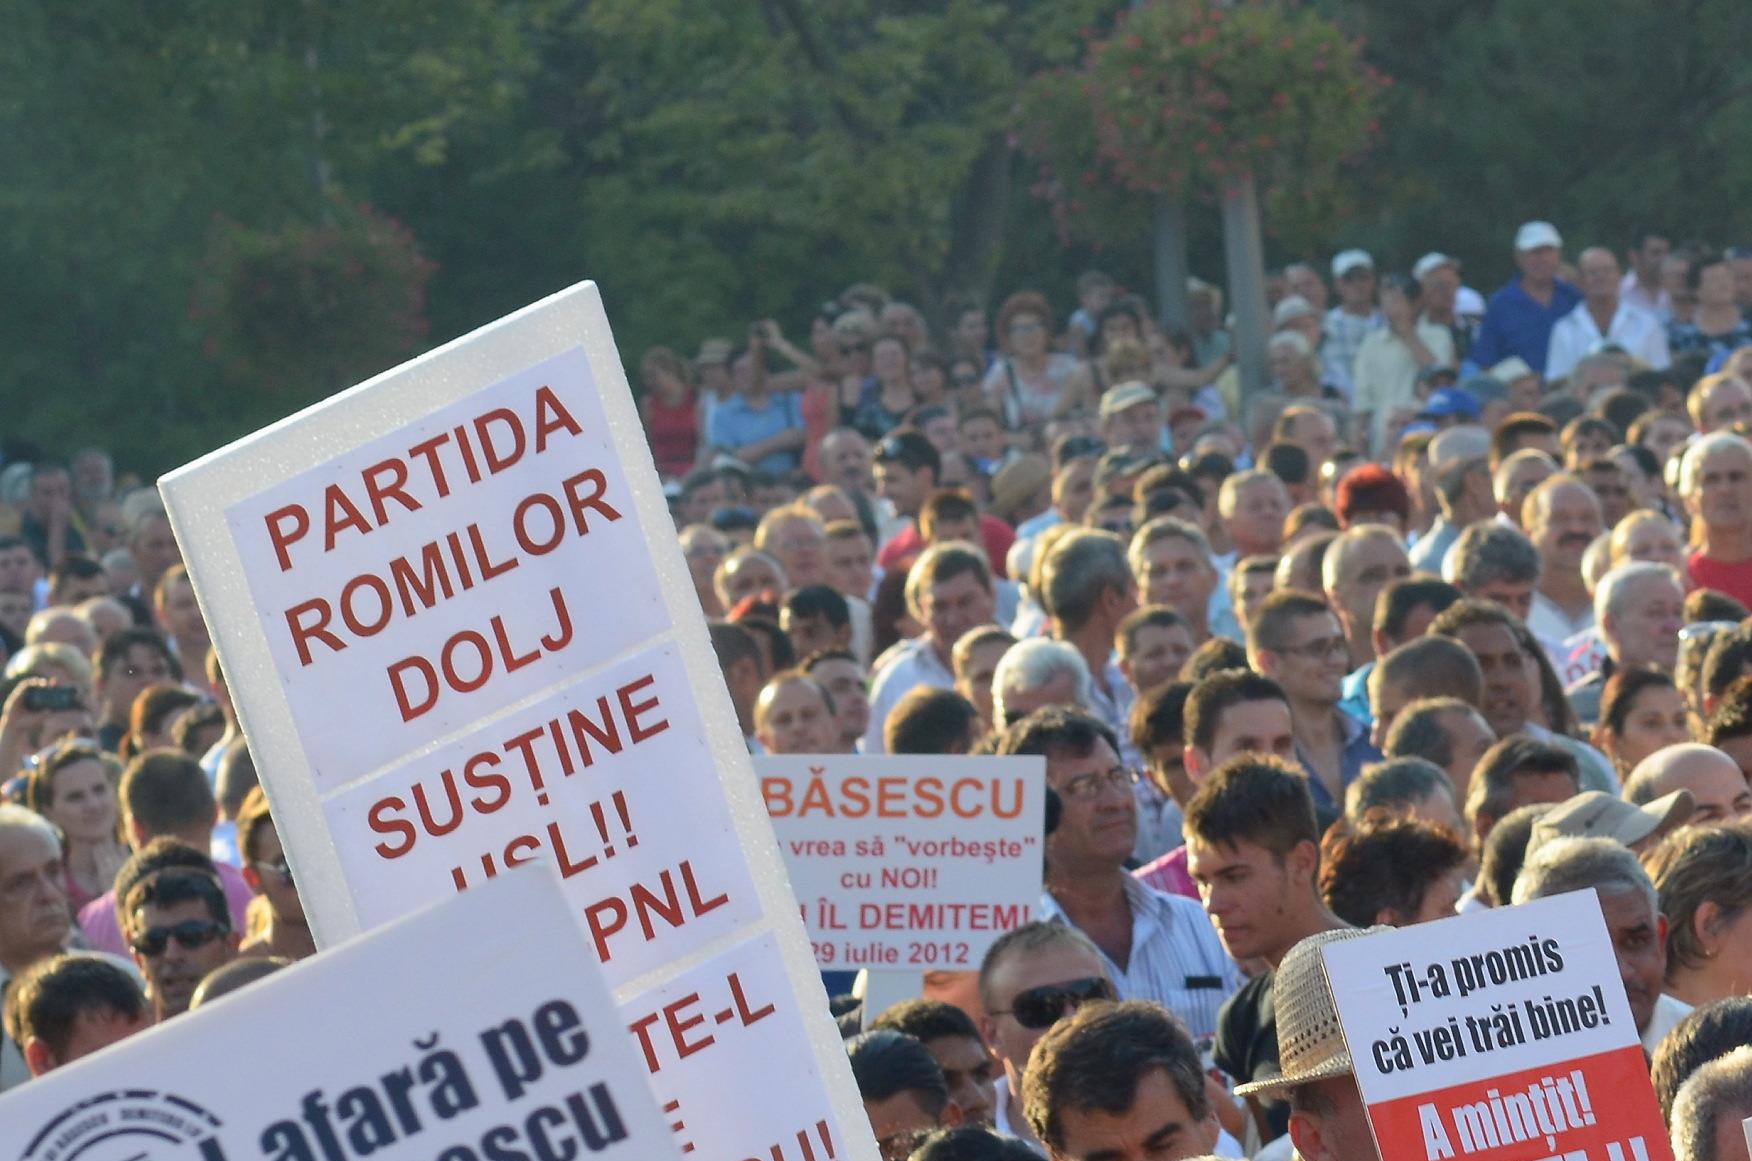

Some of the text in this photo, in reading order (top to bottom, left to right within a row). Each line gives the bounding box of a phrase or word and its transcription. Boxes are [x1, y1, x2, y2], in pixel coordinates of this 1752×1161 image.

[264, 385, 583, 572] PARTIDA
[285, 468, 622, 667] ROMILOR
[387, 586, 574, 722] DOLJ
[368, 674, 669, 859] SUSȚINE
[761, 766, 1025, 819] BĂSESCU
[790, 840, 846, 857] vrea
[855, 836, 885, 857] să
[840, 868, 938, 889] cu NOI!
[584, 860, 729, 963] PNL
[818, 897, 847, 929] ÎL
[860, 903, 1031, 930] DEMITEM!
[845, 942, 899, 963] iulie
[908, 943, 970, 964] 2012
[1384, 935, 1565, 1019] Ți-a promis
[478, 998, 591, 1102] pe
[1372, 984, 1611, 1074] că vei trăi bine!
[1452, 1068, 1597, 1155] mințit!
